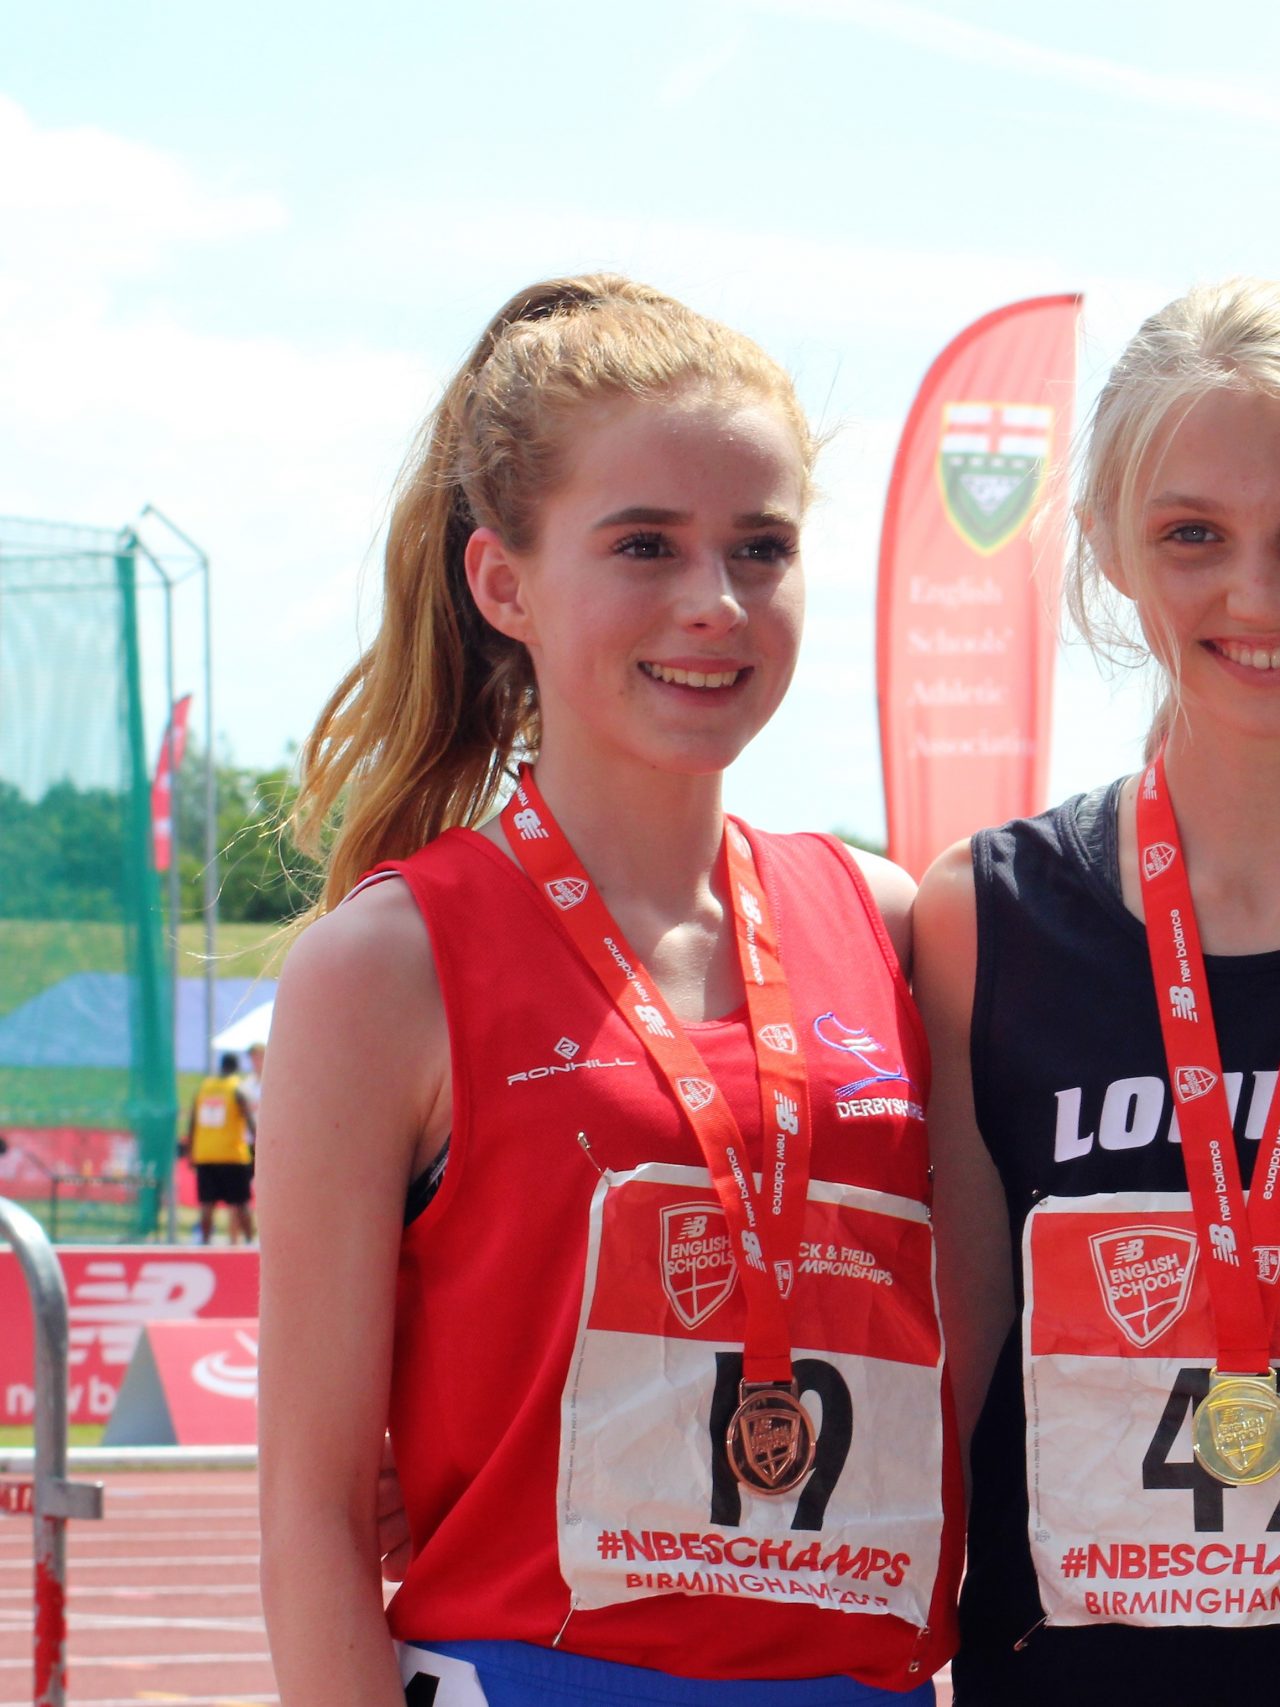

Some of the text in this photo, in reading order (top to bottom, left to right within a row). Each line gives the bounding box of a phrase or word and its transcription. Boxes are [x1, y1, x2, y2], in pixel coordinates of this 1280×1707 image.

[1170, 908, 1187, 959] balance
[603, 937, 636, 980] balance
[1180, 959, 1191, 983] new
[631, 980, 651, 1003] new
[506, 1057, 638, 1086] RONHILL
[836, 1097, 925, 1121] DERBYSH
[776, 1133, 786, 1160] new
[726, 1146, 750, 1199] balance
[1209, 1138, 1228, 1194] balance
[772, 1162, 786, 1216] balance
[744, 1201, 757, 1228] new
[1217, 1194, 1232, 1222] new
[671, 1235, 733, 1260] ENGLISH
[826, 1244, 838, 1261] &
[840, 1246, 876, 1268] FIELD
[667, 1249, 735, 1277] SCHOOLS
[797, 1259, 895, 1287] MPIONSHIPS
[1109, 1253, 1181, 1285] ENGLISH
[1109, 1268, 1186, 1301] SCHOOLS
[597, 1529, 912, 1588] #NBESCHAMPS
[625, 1571, 833, 1601] BIRMINGHAM
